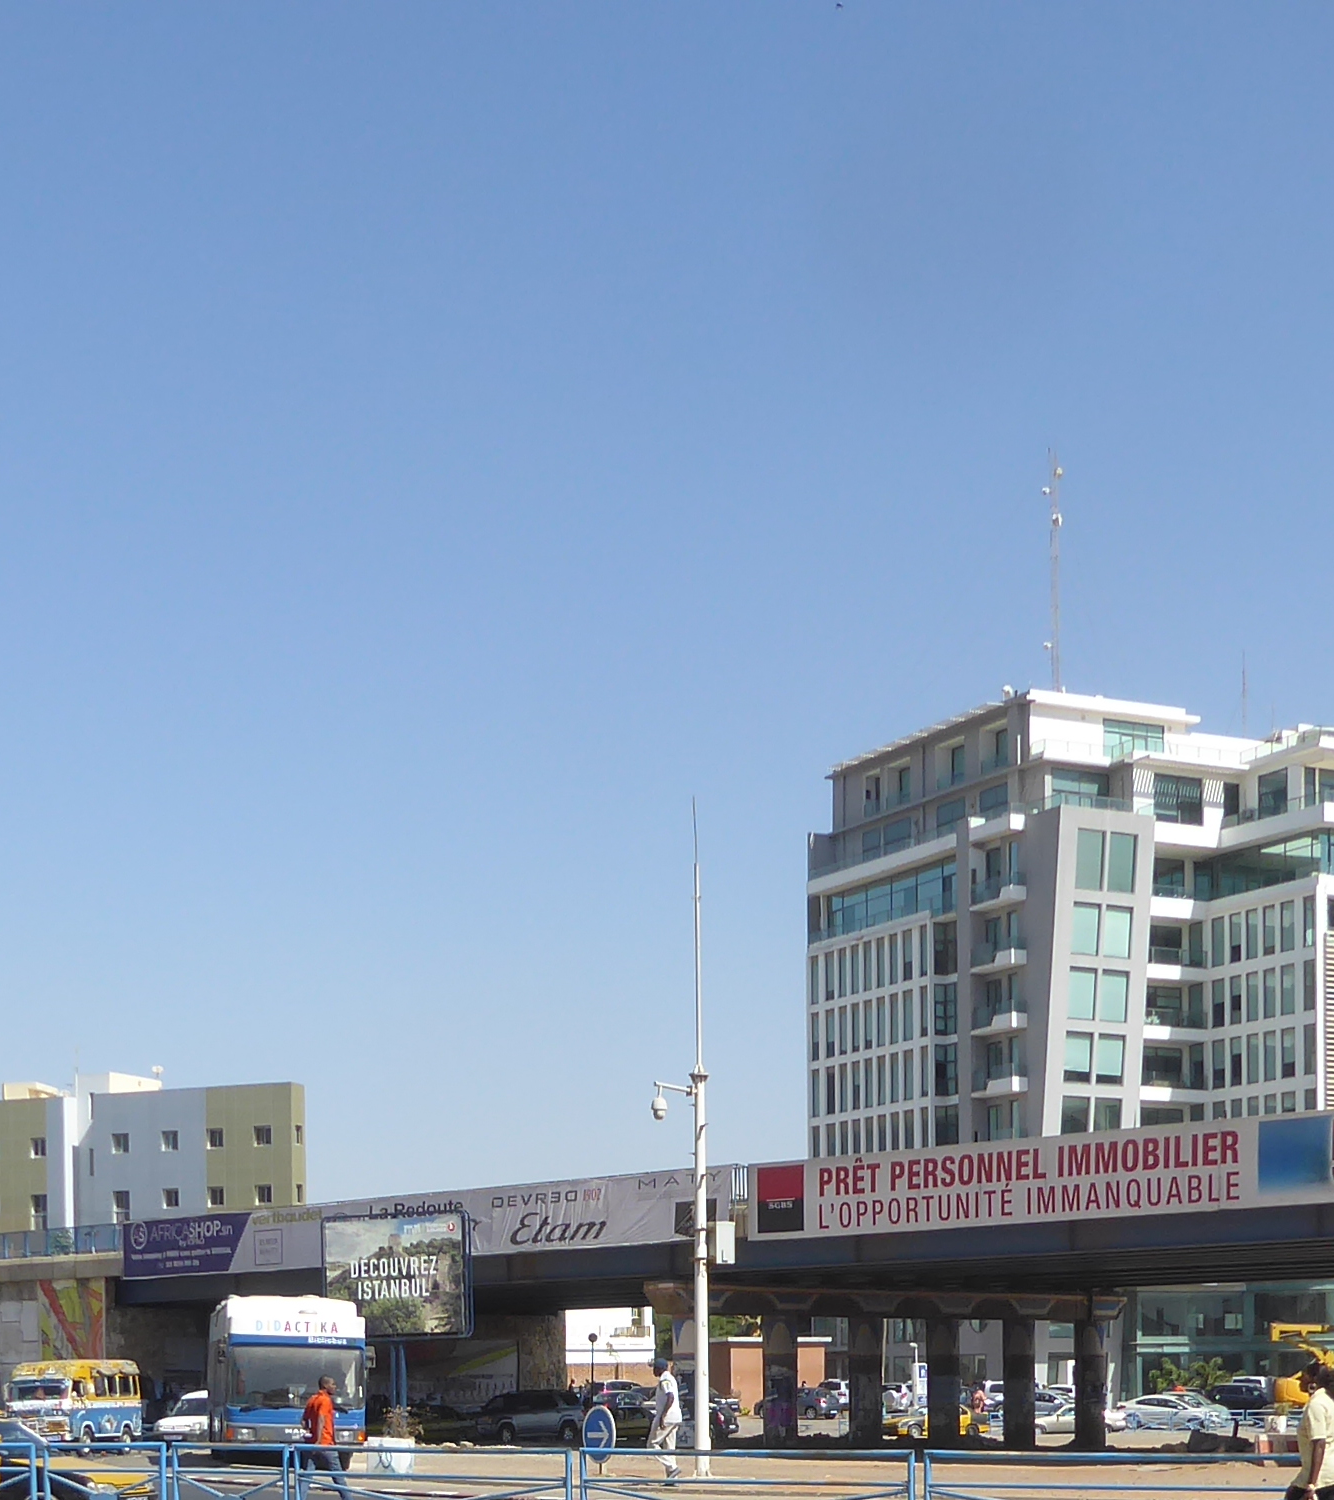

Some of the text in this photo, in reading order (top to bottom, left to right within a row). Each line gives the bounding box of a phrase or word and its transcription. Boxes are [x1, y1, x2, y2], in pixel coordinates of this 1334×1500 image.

[819, 1130, 1240, 1197] PRÊT PERSONNEL IMMOBILIER
[1026, 1171, 1240, 1215] IMMANQUABLE
[369, 1205, 388, 1219] La
[394, 1200, 463, 1218] Redoute
[768, 1201, 793, 1210] SGBS
[510, 1211, 607, 1246] Etam
[358, 1278, 430, 1300] ISTANBUL
[255, 1320, 338, 1334] DIDACTIKA
